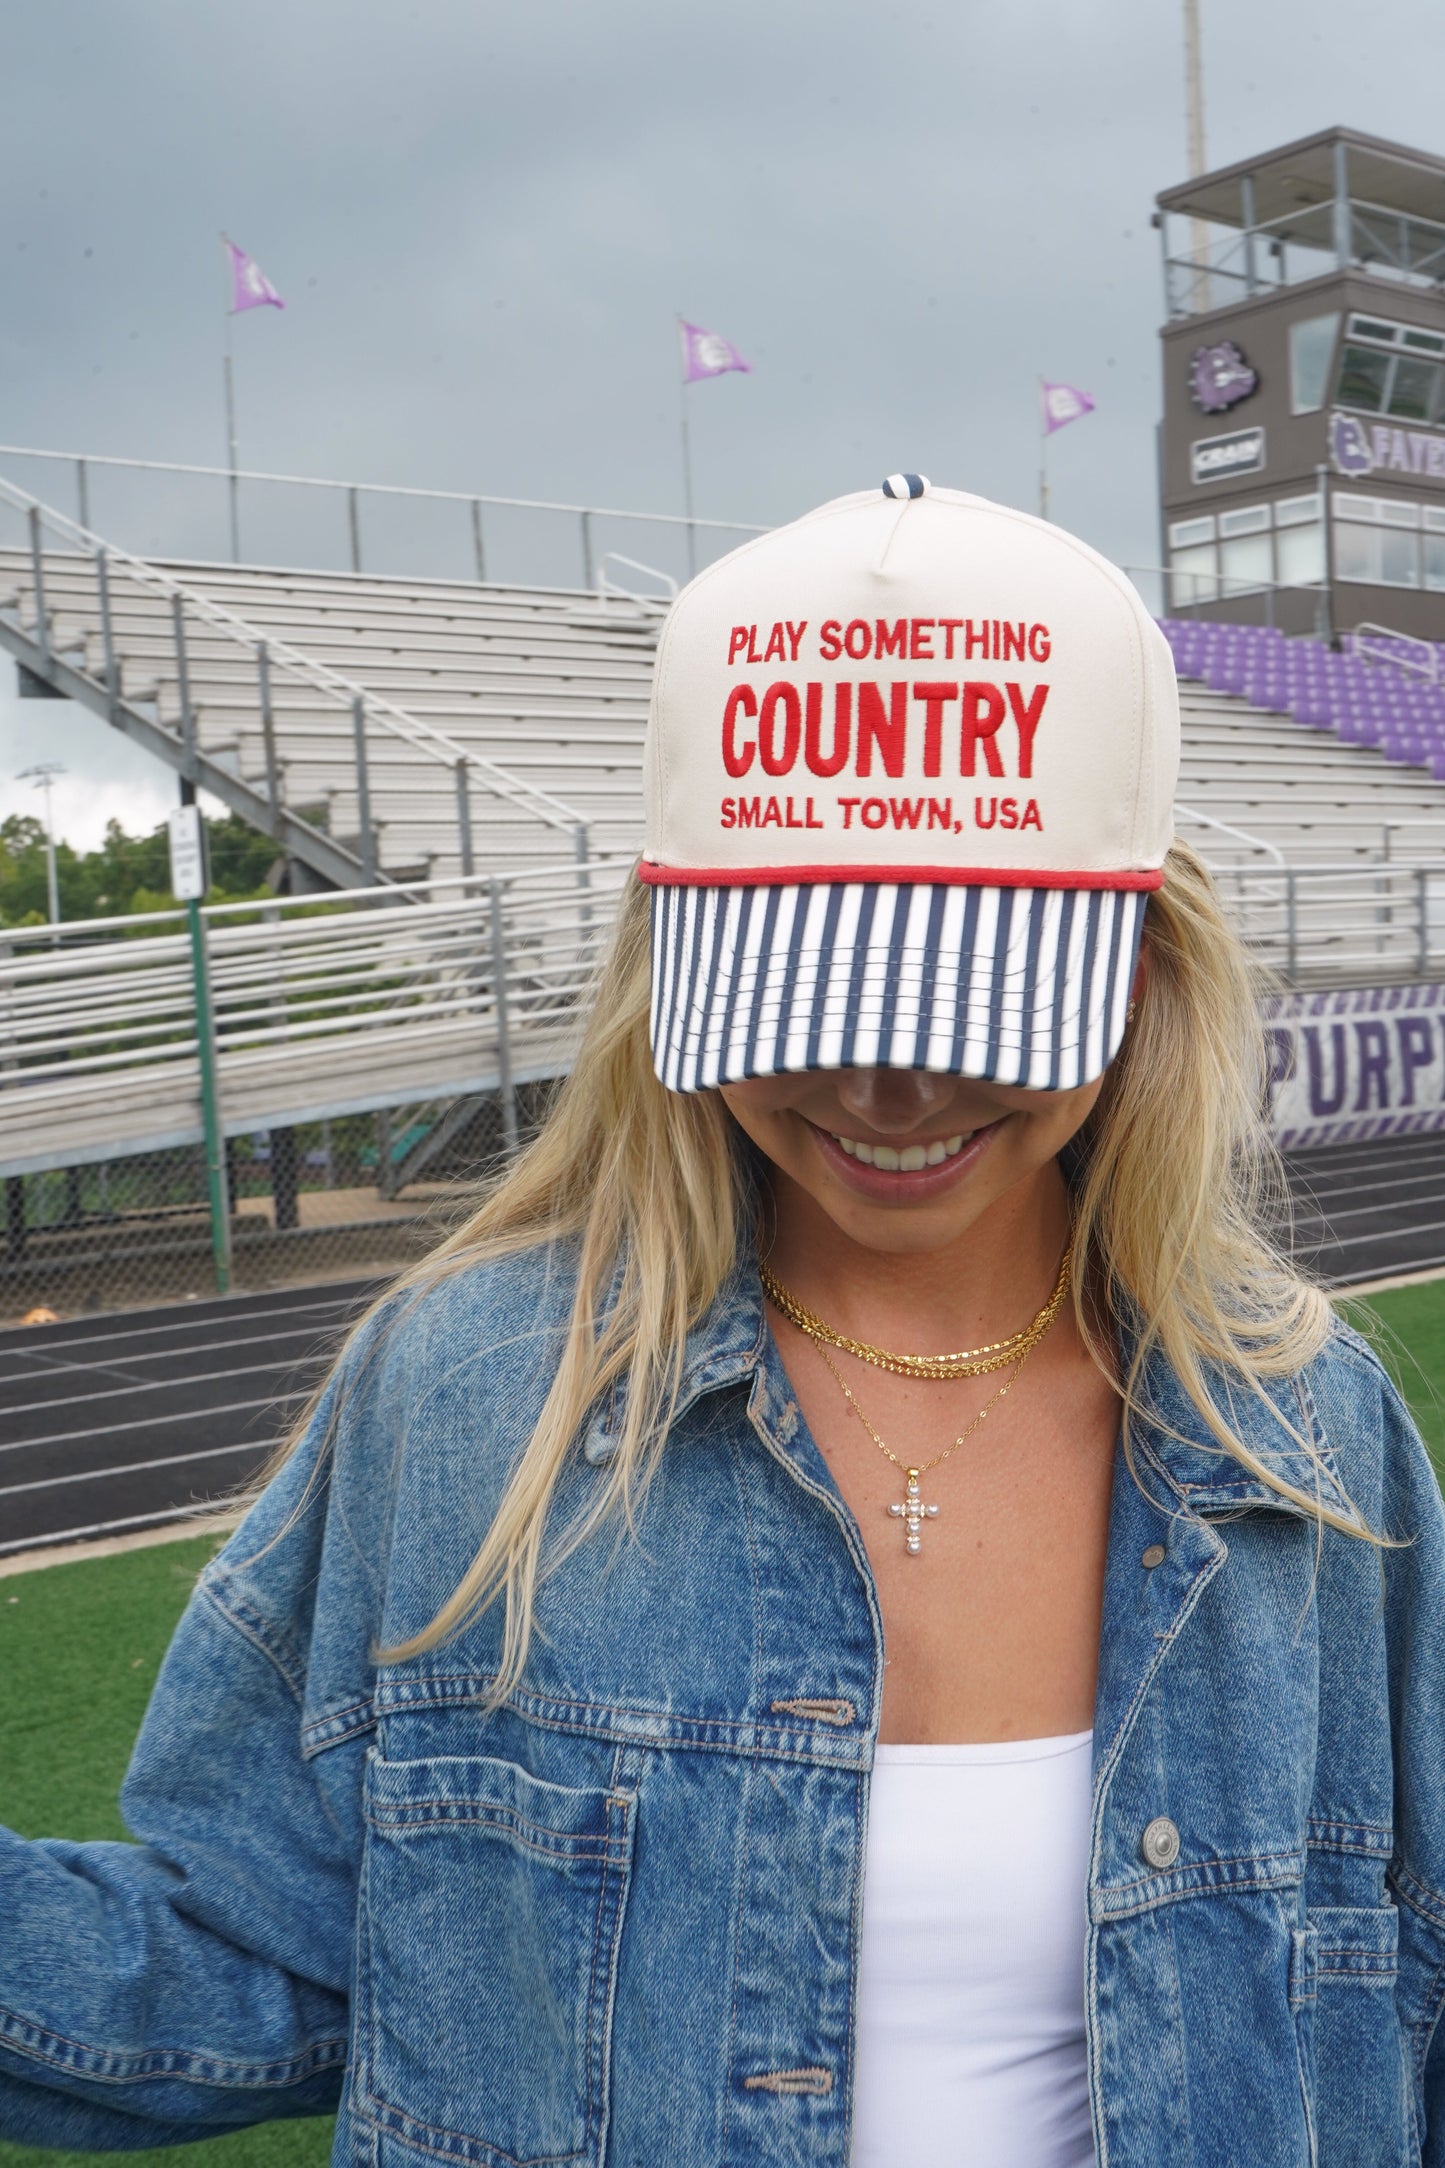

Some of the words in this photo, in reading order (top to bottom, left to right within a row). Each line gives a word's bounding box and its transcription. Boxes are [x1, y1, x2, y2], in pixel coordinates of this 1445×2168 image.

[728, 621, 807, 664] PLAY
[820, 618, 1051, 662] SOMETHING
[722, 681, 1049, 778] COUNTRY
[721, 796, 823, 828] SMALL
[837, 798, 962, 834] TOWN,
[975, 797, 1042, 831] USA
[1259, 1014, 1445, 1124] PURP
